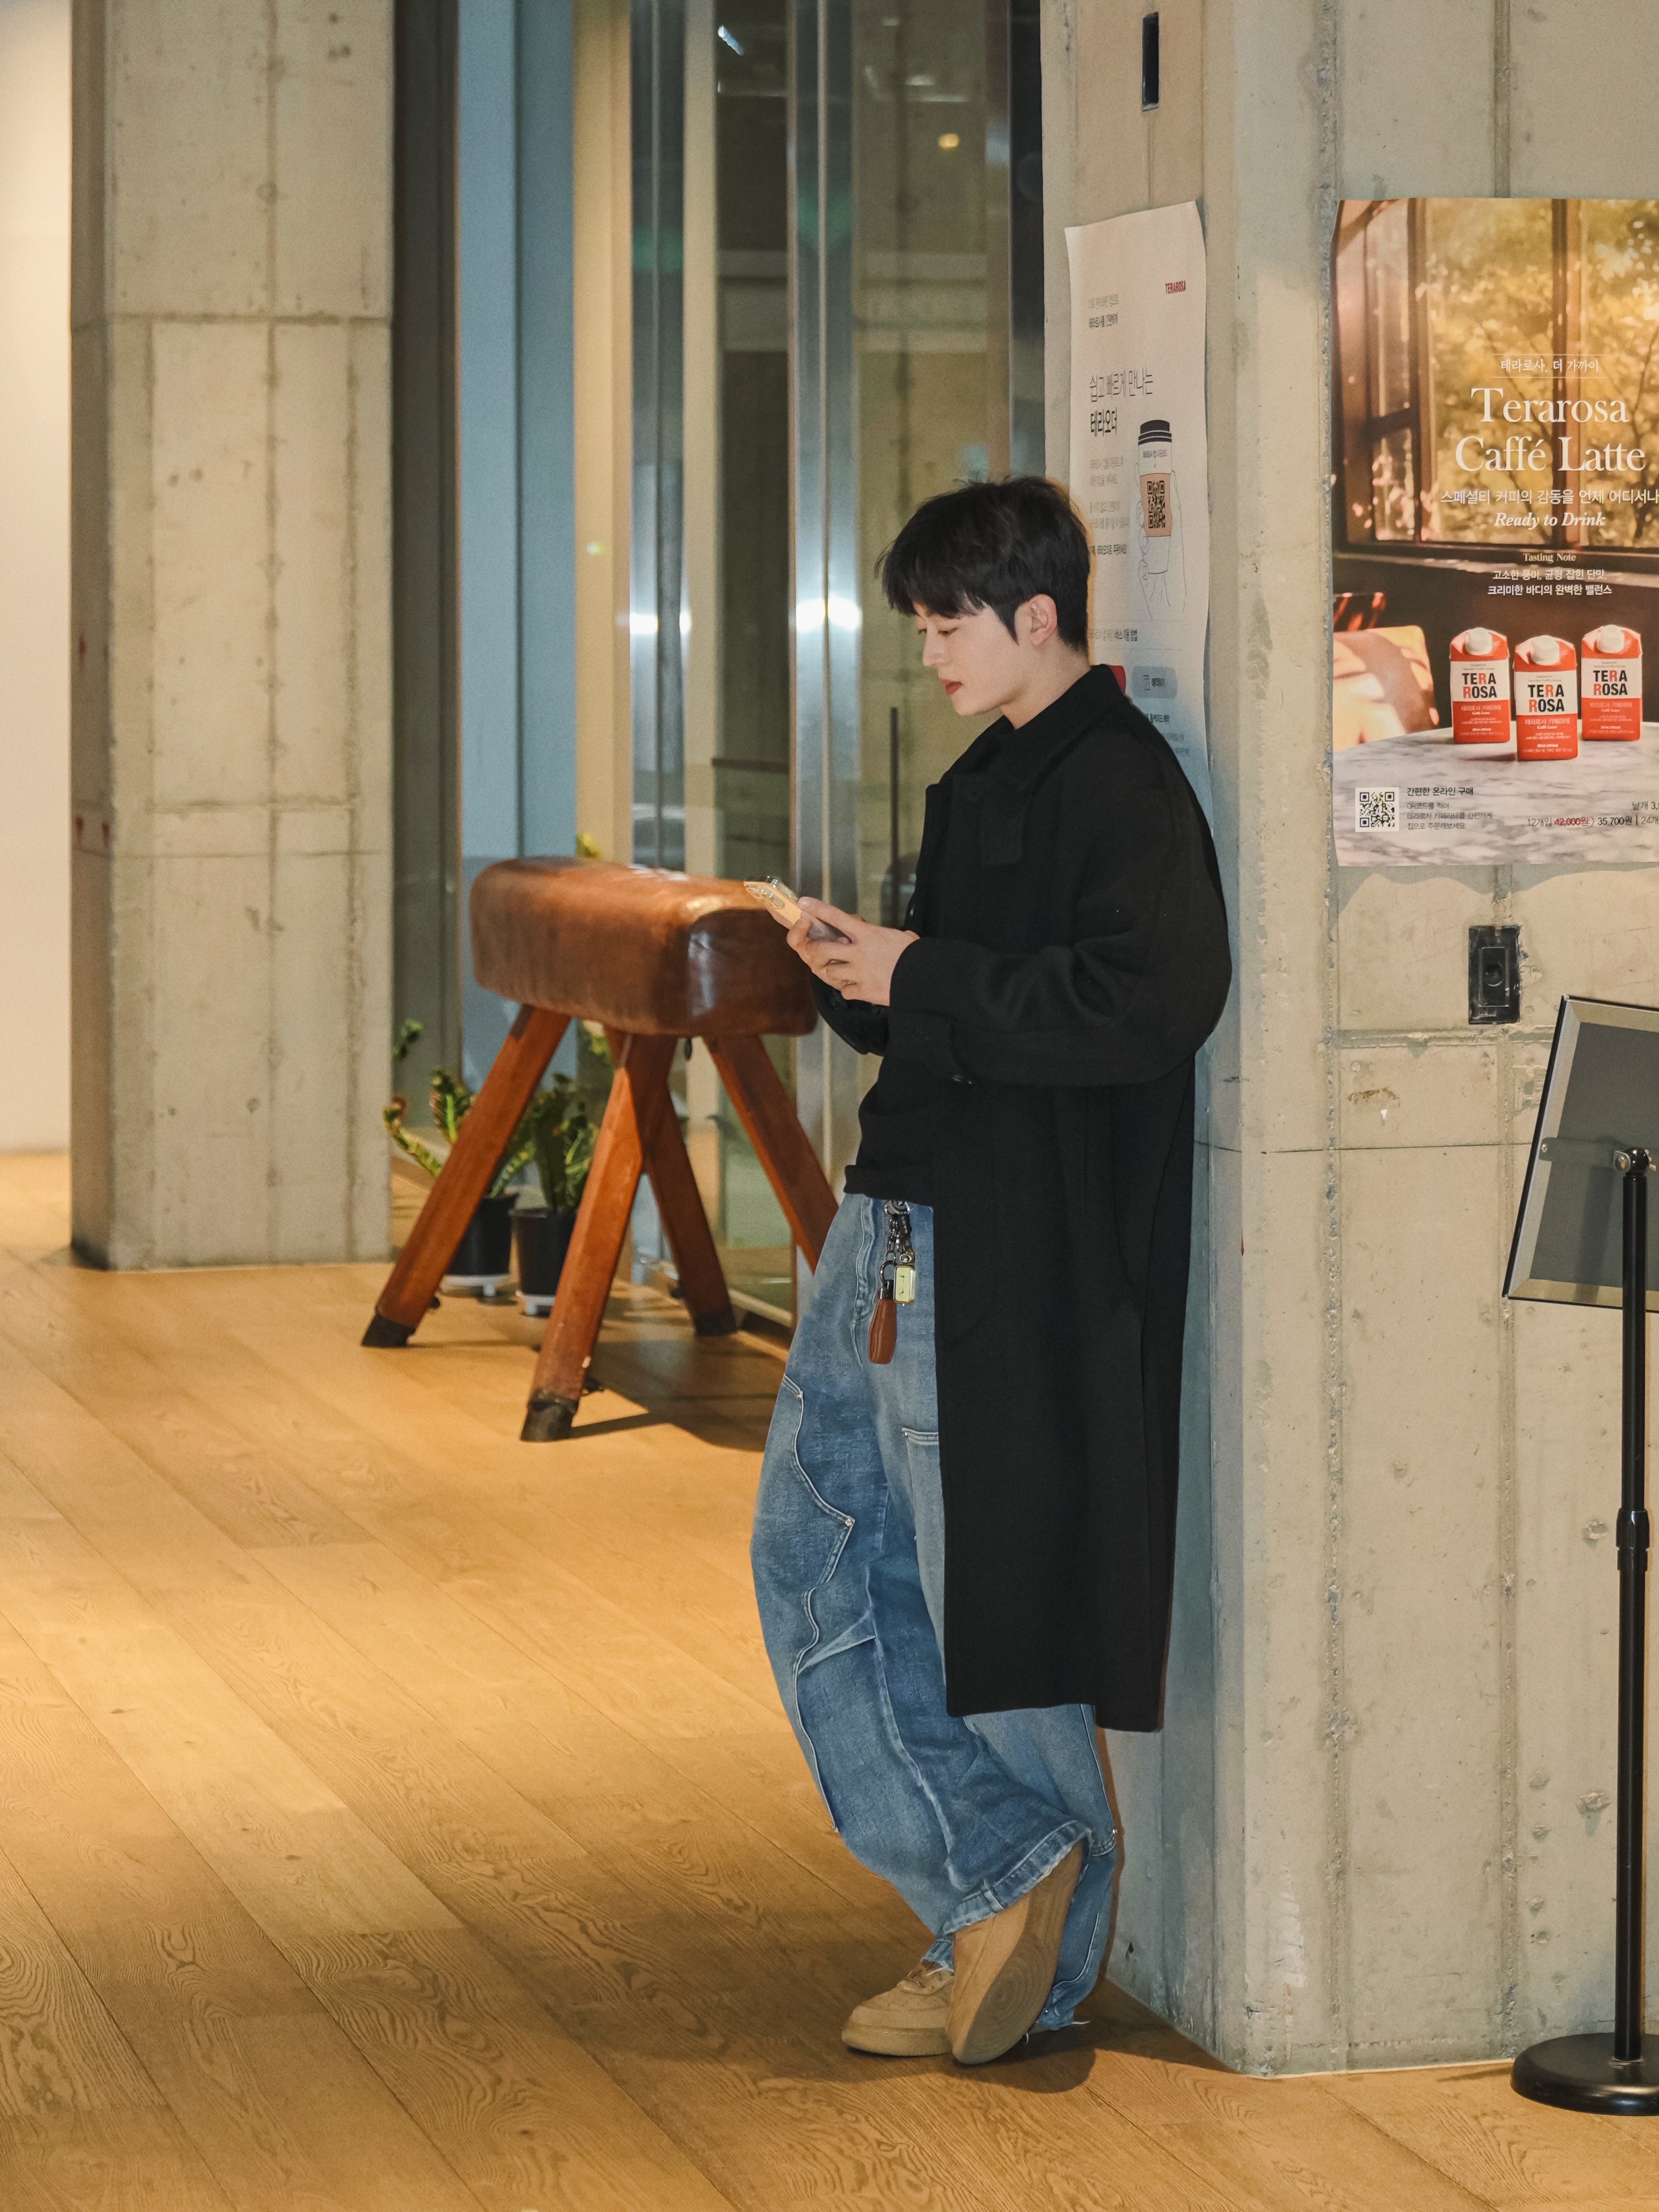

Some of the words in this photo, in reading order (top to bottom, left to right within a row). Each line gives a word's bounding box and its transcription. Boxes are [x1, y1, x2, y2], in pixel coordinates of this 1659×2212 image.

[1165, 281, 1186, 294] TERAROSA
[1500, 359, 1548, 373] 테라로사.
[1552, 359, 1563, 373] 더
[1566, 359, 1599, 373] 가까이
[1089, 374, 1105, 402] 쉽고
[1106, 369, 1126, 398] 빠르게
[1128, 367, 1154, 397] 만나는
[1470, 387, 1630, 423] Terarosa
[1090, 407, 1117, 437] 테라오더
[1455, 435, 1547, 472] Caffé
[1557, 436, 1646, 472] Latte
[1440, 489, 1491, 505] 스페셜티
[1495, 489, 1533, 505] 커피의
[1537, 489, 1575, 505] 감동을
[1579, 488, 1604, 505] 언제
[1493, 512, 1540, 530] Ready
[1543, 513, 1559, 527] to
[1561, 512, 1606, 527] Drink
[1522, 553, 1554, 564] Tasting
[1556, 553, 1577, 562] Note
[1492, 569, 1520, 581] 고소한
[1544, 569, 1563, 581] 균형
[1565, 569, 1584, 581] 잡힌
[1487, 584, 1523, 596] 크리미한
[1526, 584, 1553, 596] 바디의
[1555, 584, 1582, 596] 완벽한
[1585, 584, 1613, 595] 밸런스
[1462, 673, 1496, 685] TERA
[1593, 670, 1628, 682] TERA
[1462, 685, 1498, 699] ROSA
[1527, 684, 1564, 697] TERA
[1593, 683, 1628, 696] ROSA
[1528, 698, 1565, 712] ROSA
[1406, 787, 1430, 796] 간편한
[1432, 787, 1455, 796] 온라인
[1458, 787, 1473, 796] 구매
[1632, 801, 1648, 811] 낱개
[1527, 818, 1552, 827] 12개입
[1597, 816, 1632, 826] 35,700원
